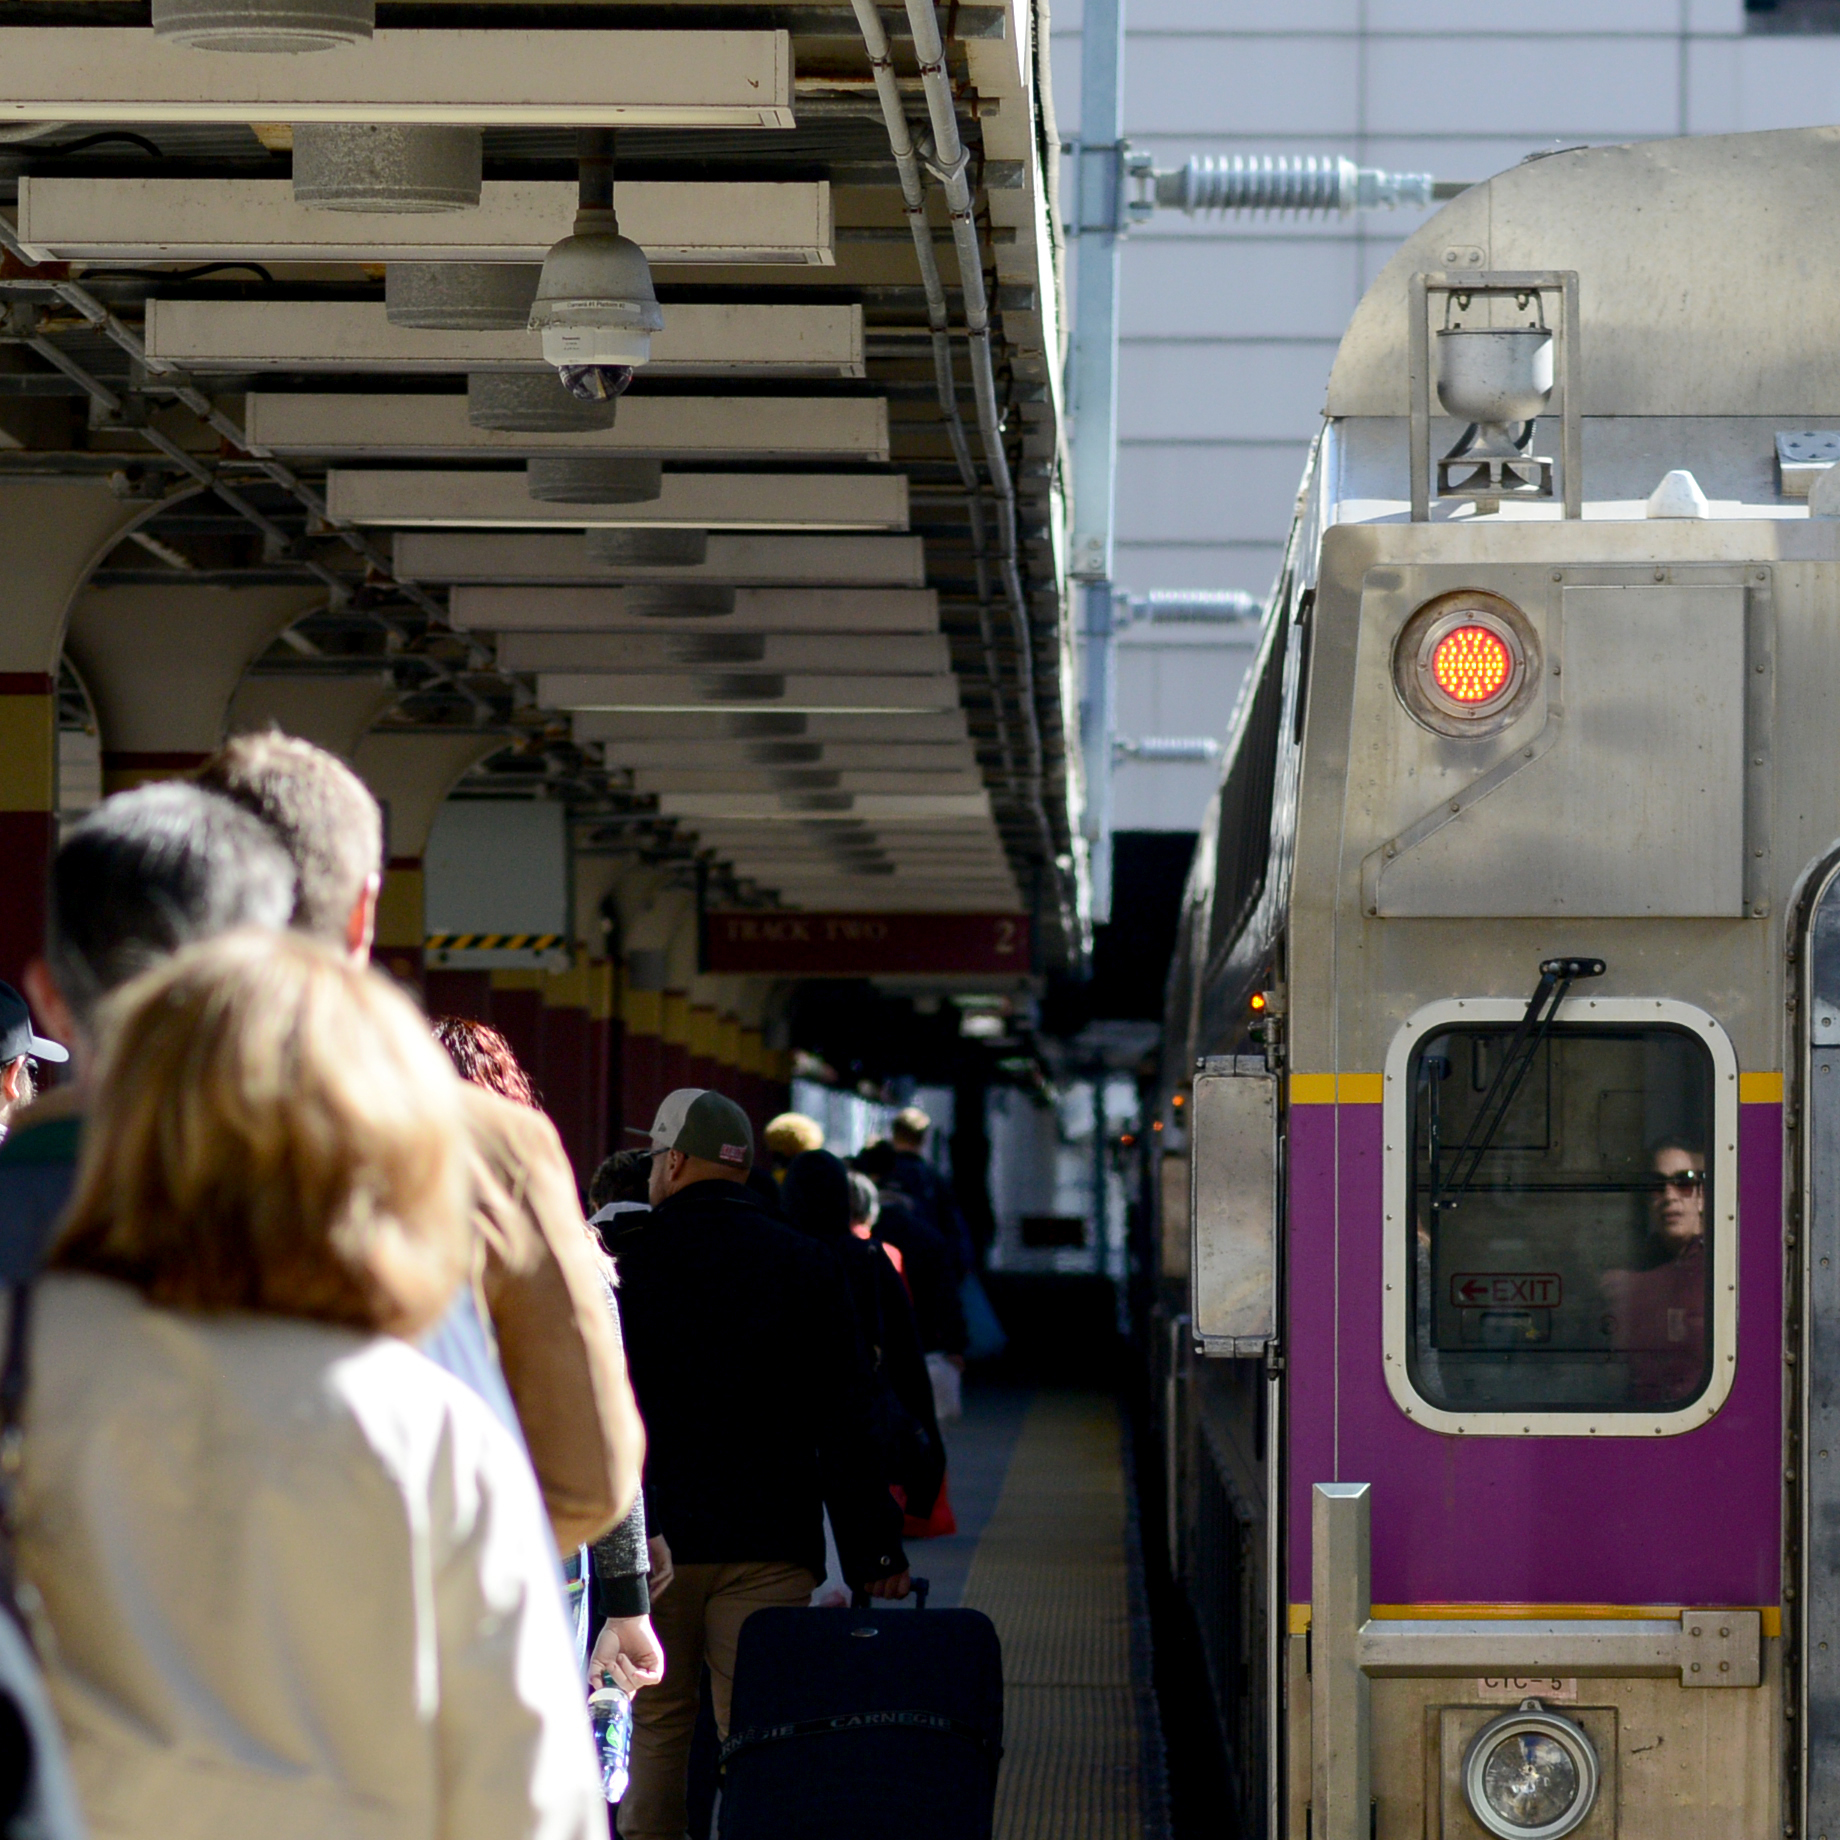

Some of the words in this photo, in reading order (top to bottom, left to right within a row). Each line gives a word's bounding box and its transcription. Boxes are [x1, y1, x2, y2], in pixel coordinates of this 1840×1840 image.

[726, 919, 810, 942] TRACK
[825, 919, 889, 942] TWO
[993, 918, 1017, 955] 2
[1492, 1280, 1554, 1301] EXIT
[829, 1711, 952, 1729] CARNEGIE
